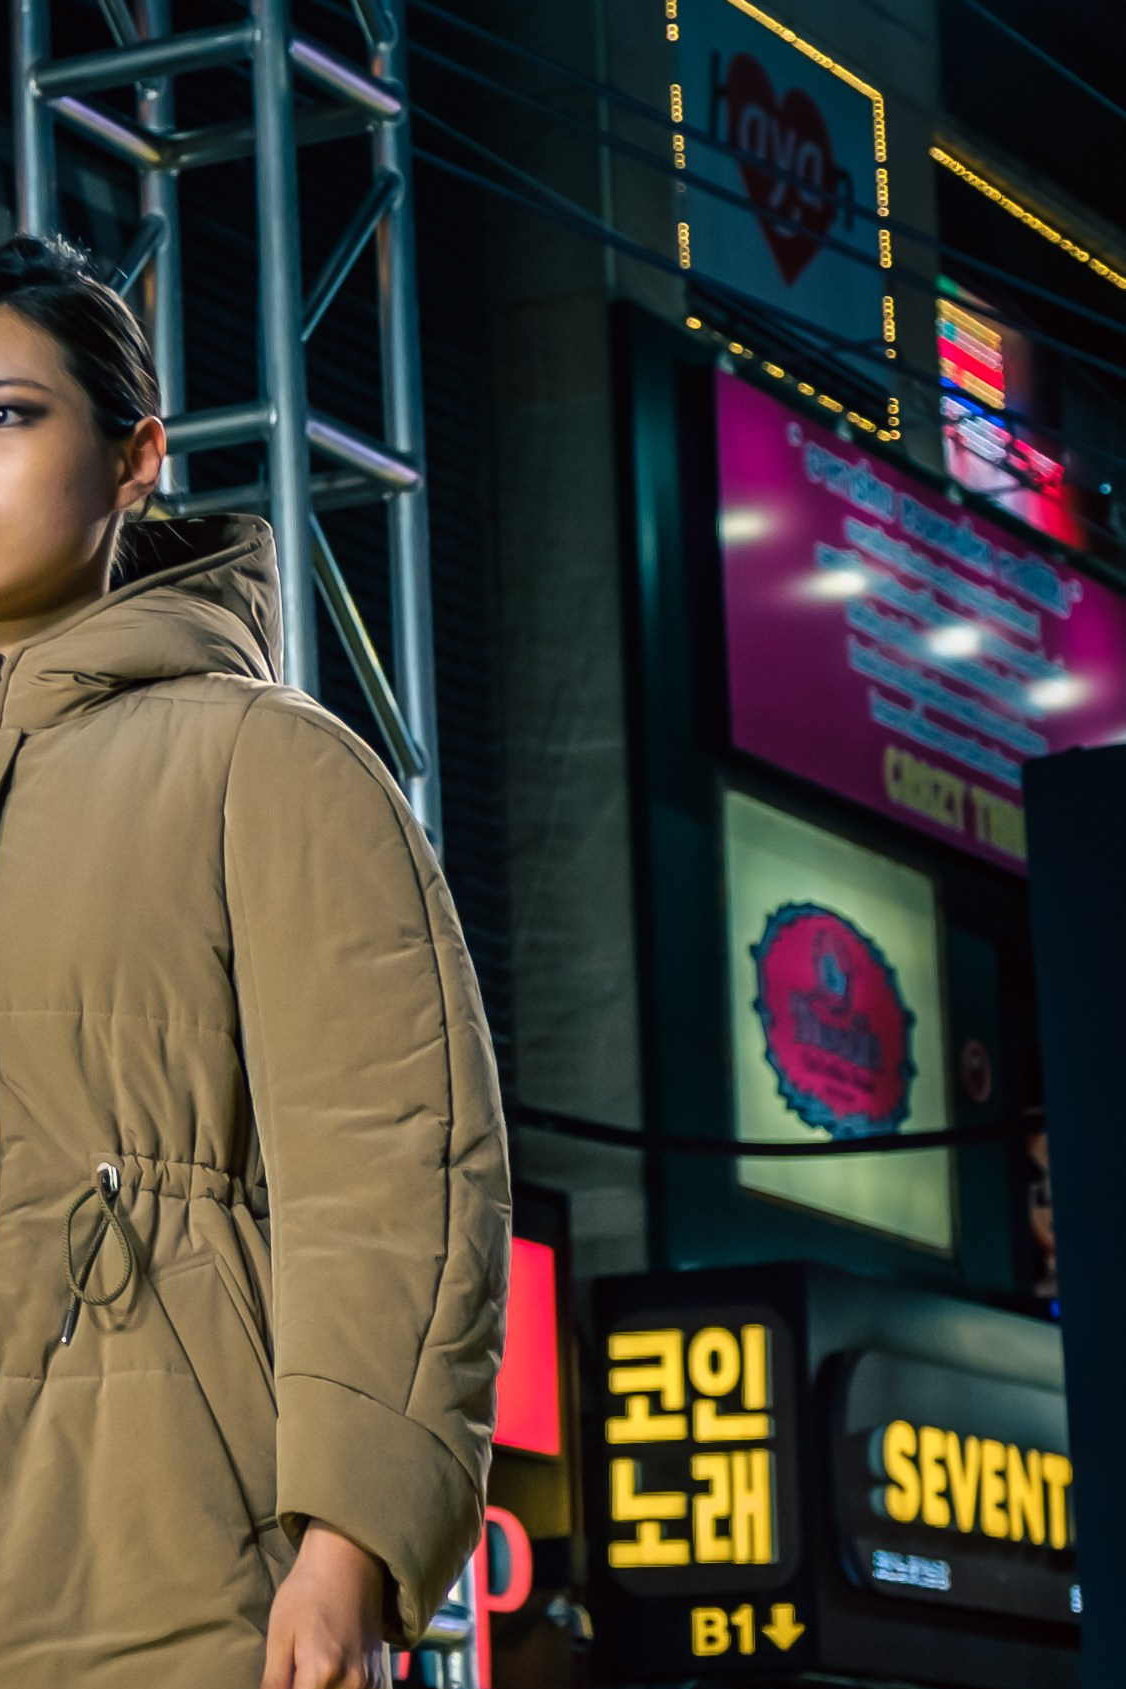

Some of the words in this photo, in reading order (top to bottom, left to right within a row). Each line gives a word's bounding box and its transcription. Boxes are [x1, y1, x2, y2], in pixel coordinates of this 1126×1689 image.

[605, 1324, 771, 1444] 코인
[608, 1448, 774, 1568] 노래
[882, 1419, 1073, 1550] SEVENT
[690, 1603, 757, 1656] B1
